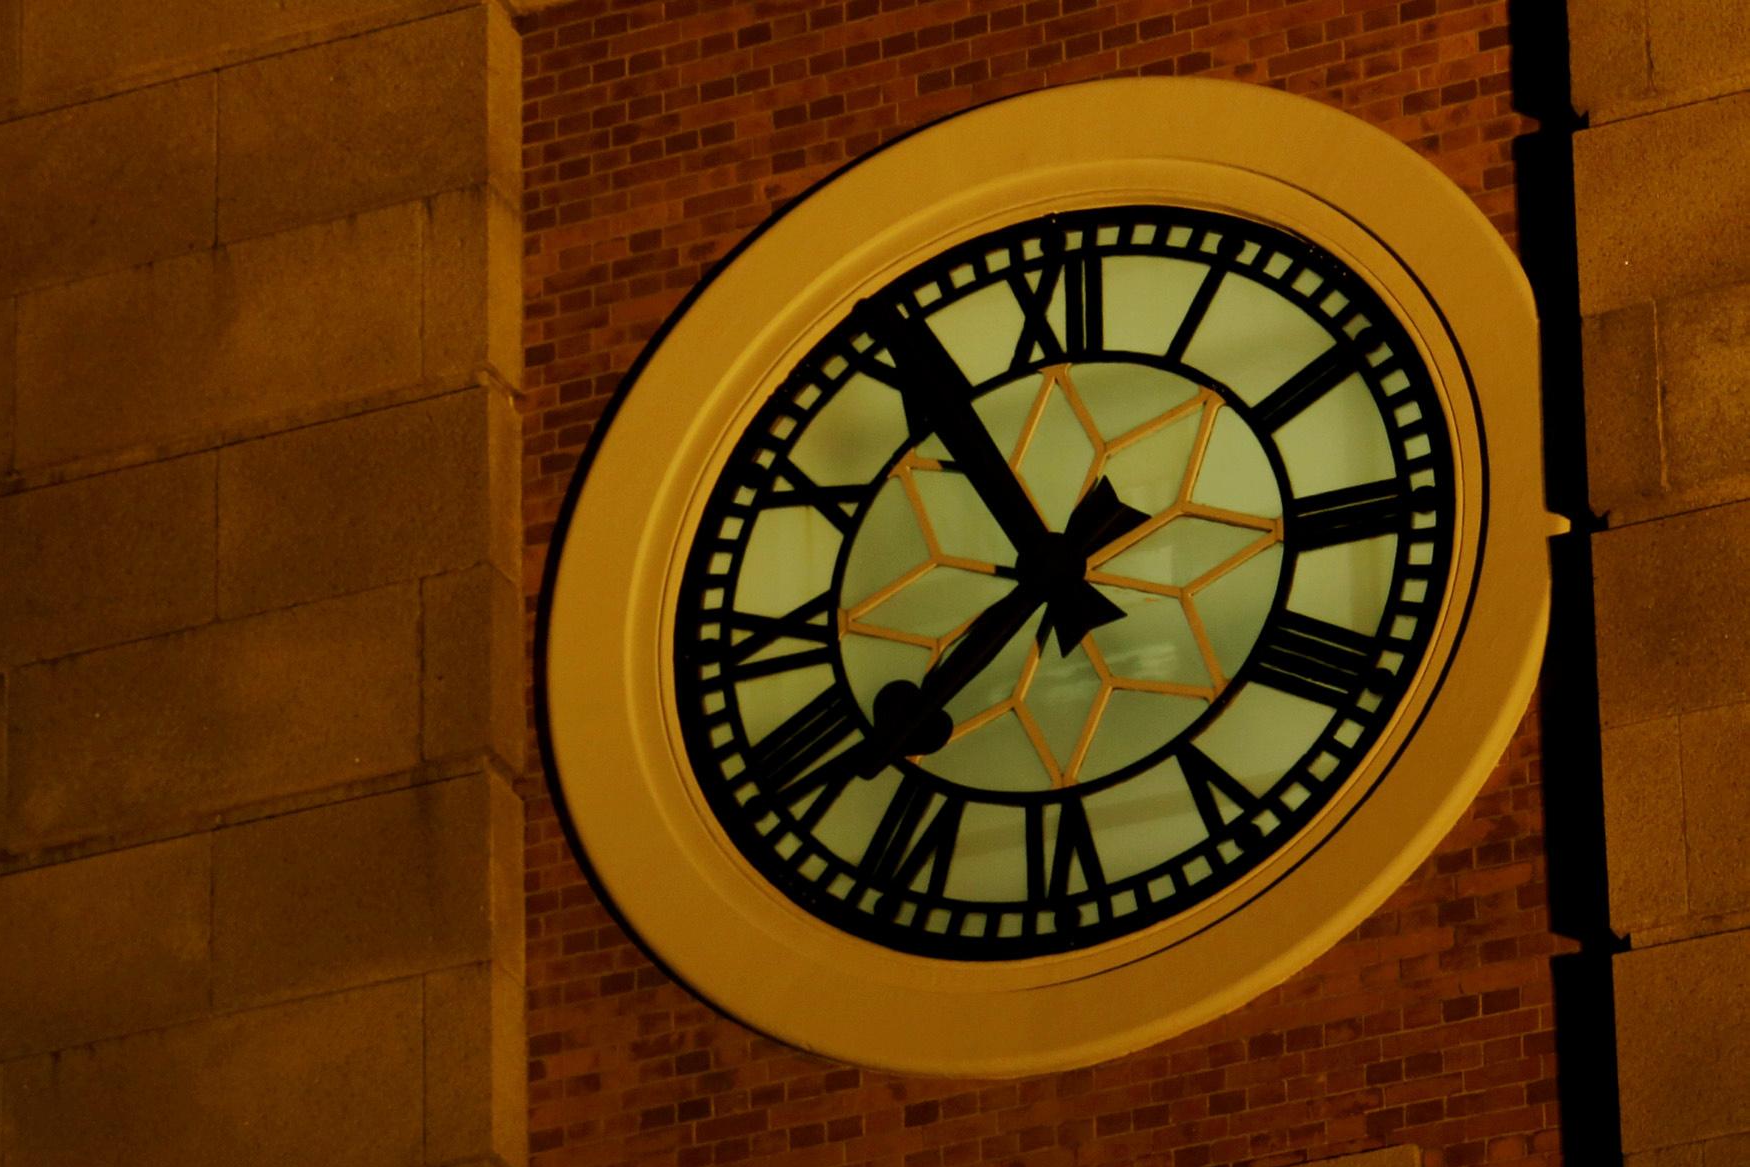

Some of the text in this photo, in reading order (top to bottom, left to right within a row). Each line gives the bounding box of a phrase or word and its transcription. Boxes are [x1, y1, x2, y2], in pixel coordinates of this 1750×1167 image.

[1002, 250, 1103, 368] XII
[1248, 342, 1359, 434] II
[757, 454, 872, 534] X
[728, 588, 836, 684] IX
[854, 772, 964, 902] VII
[1172, 742, 1262, 844] V
[1024, 797, 1108, 902] VI
